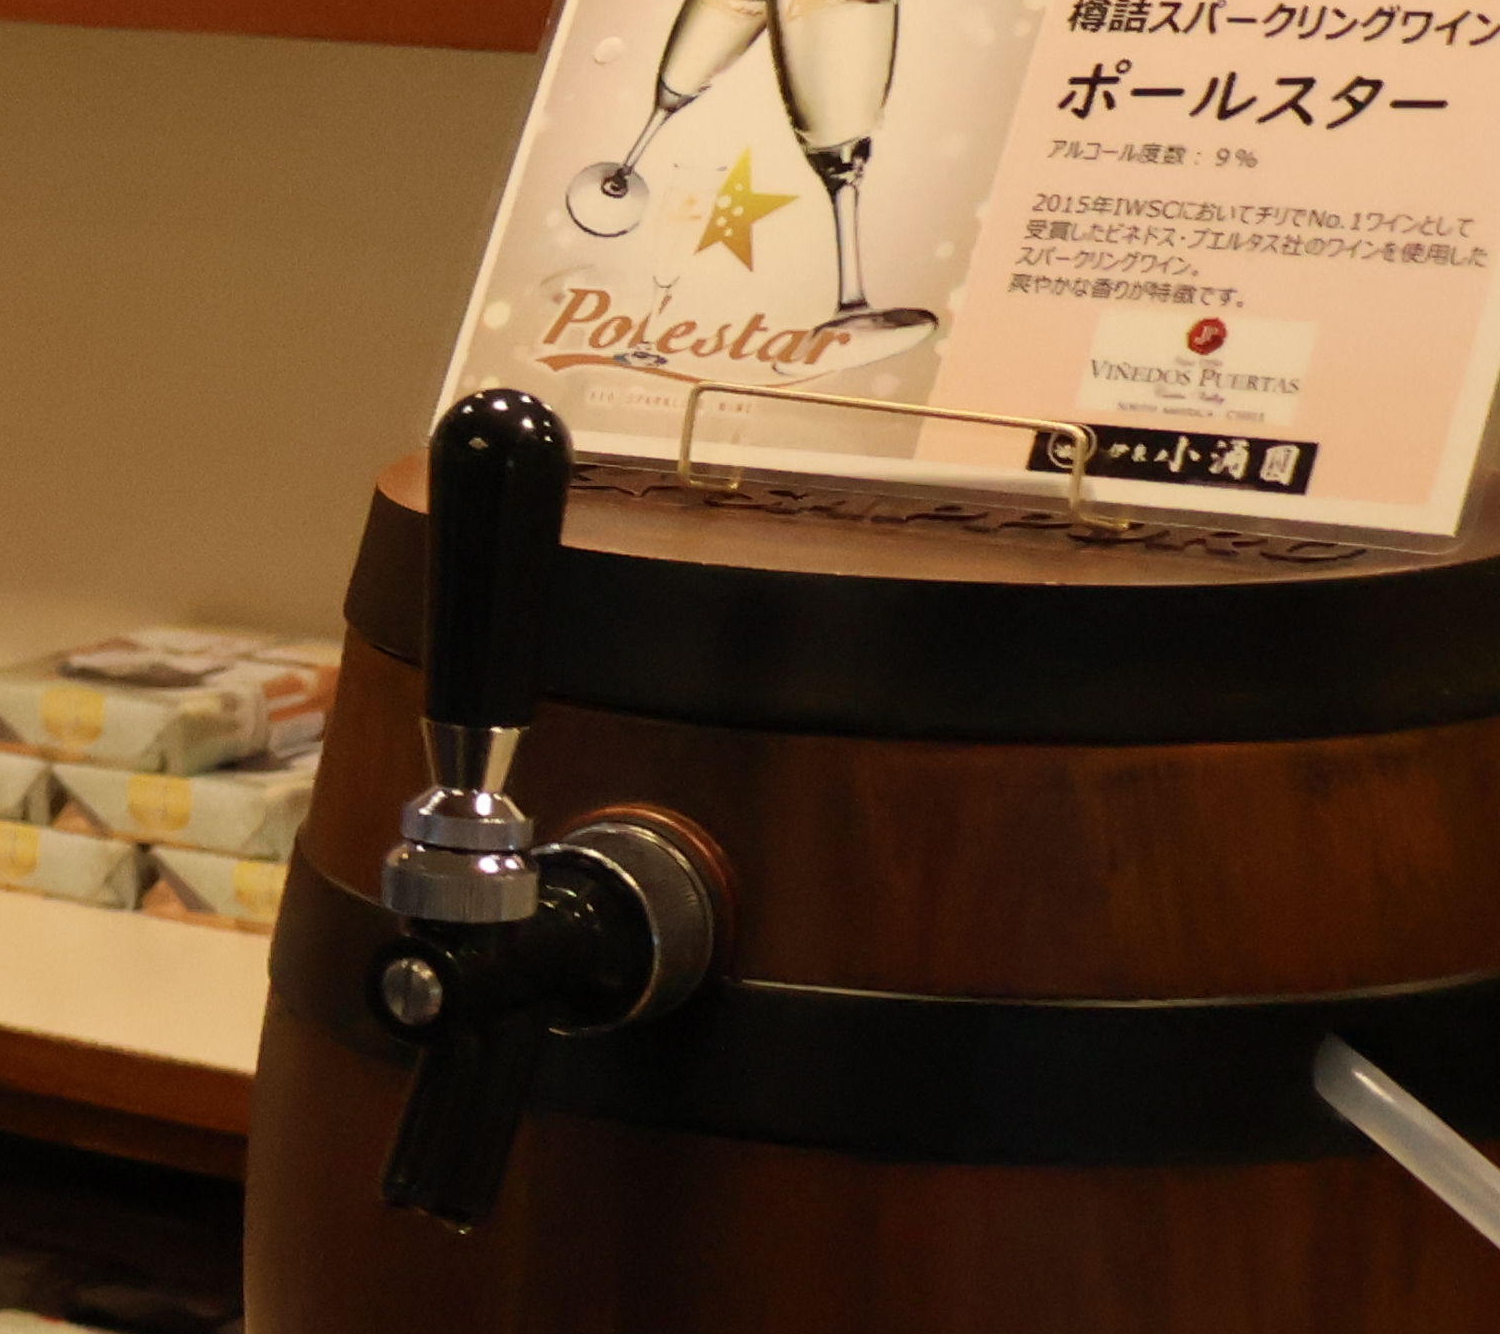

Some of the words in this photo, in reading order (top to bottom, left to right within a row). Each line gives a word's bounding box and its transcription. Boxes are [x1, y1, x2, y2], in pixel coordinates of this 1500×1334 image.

[1058, 59, 1449, 130] ポールスター
[543, 288, 852, 365] Polestar
